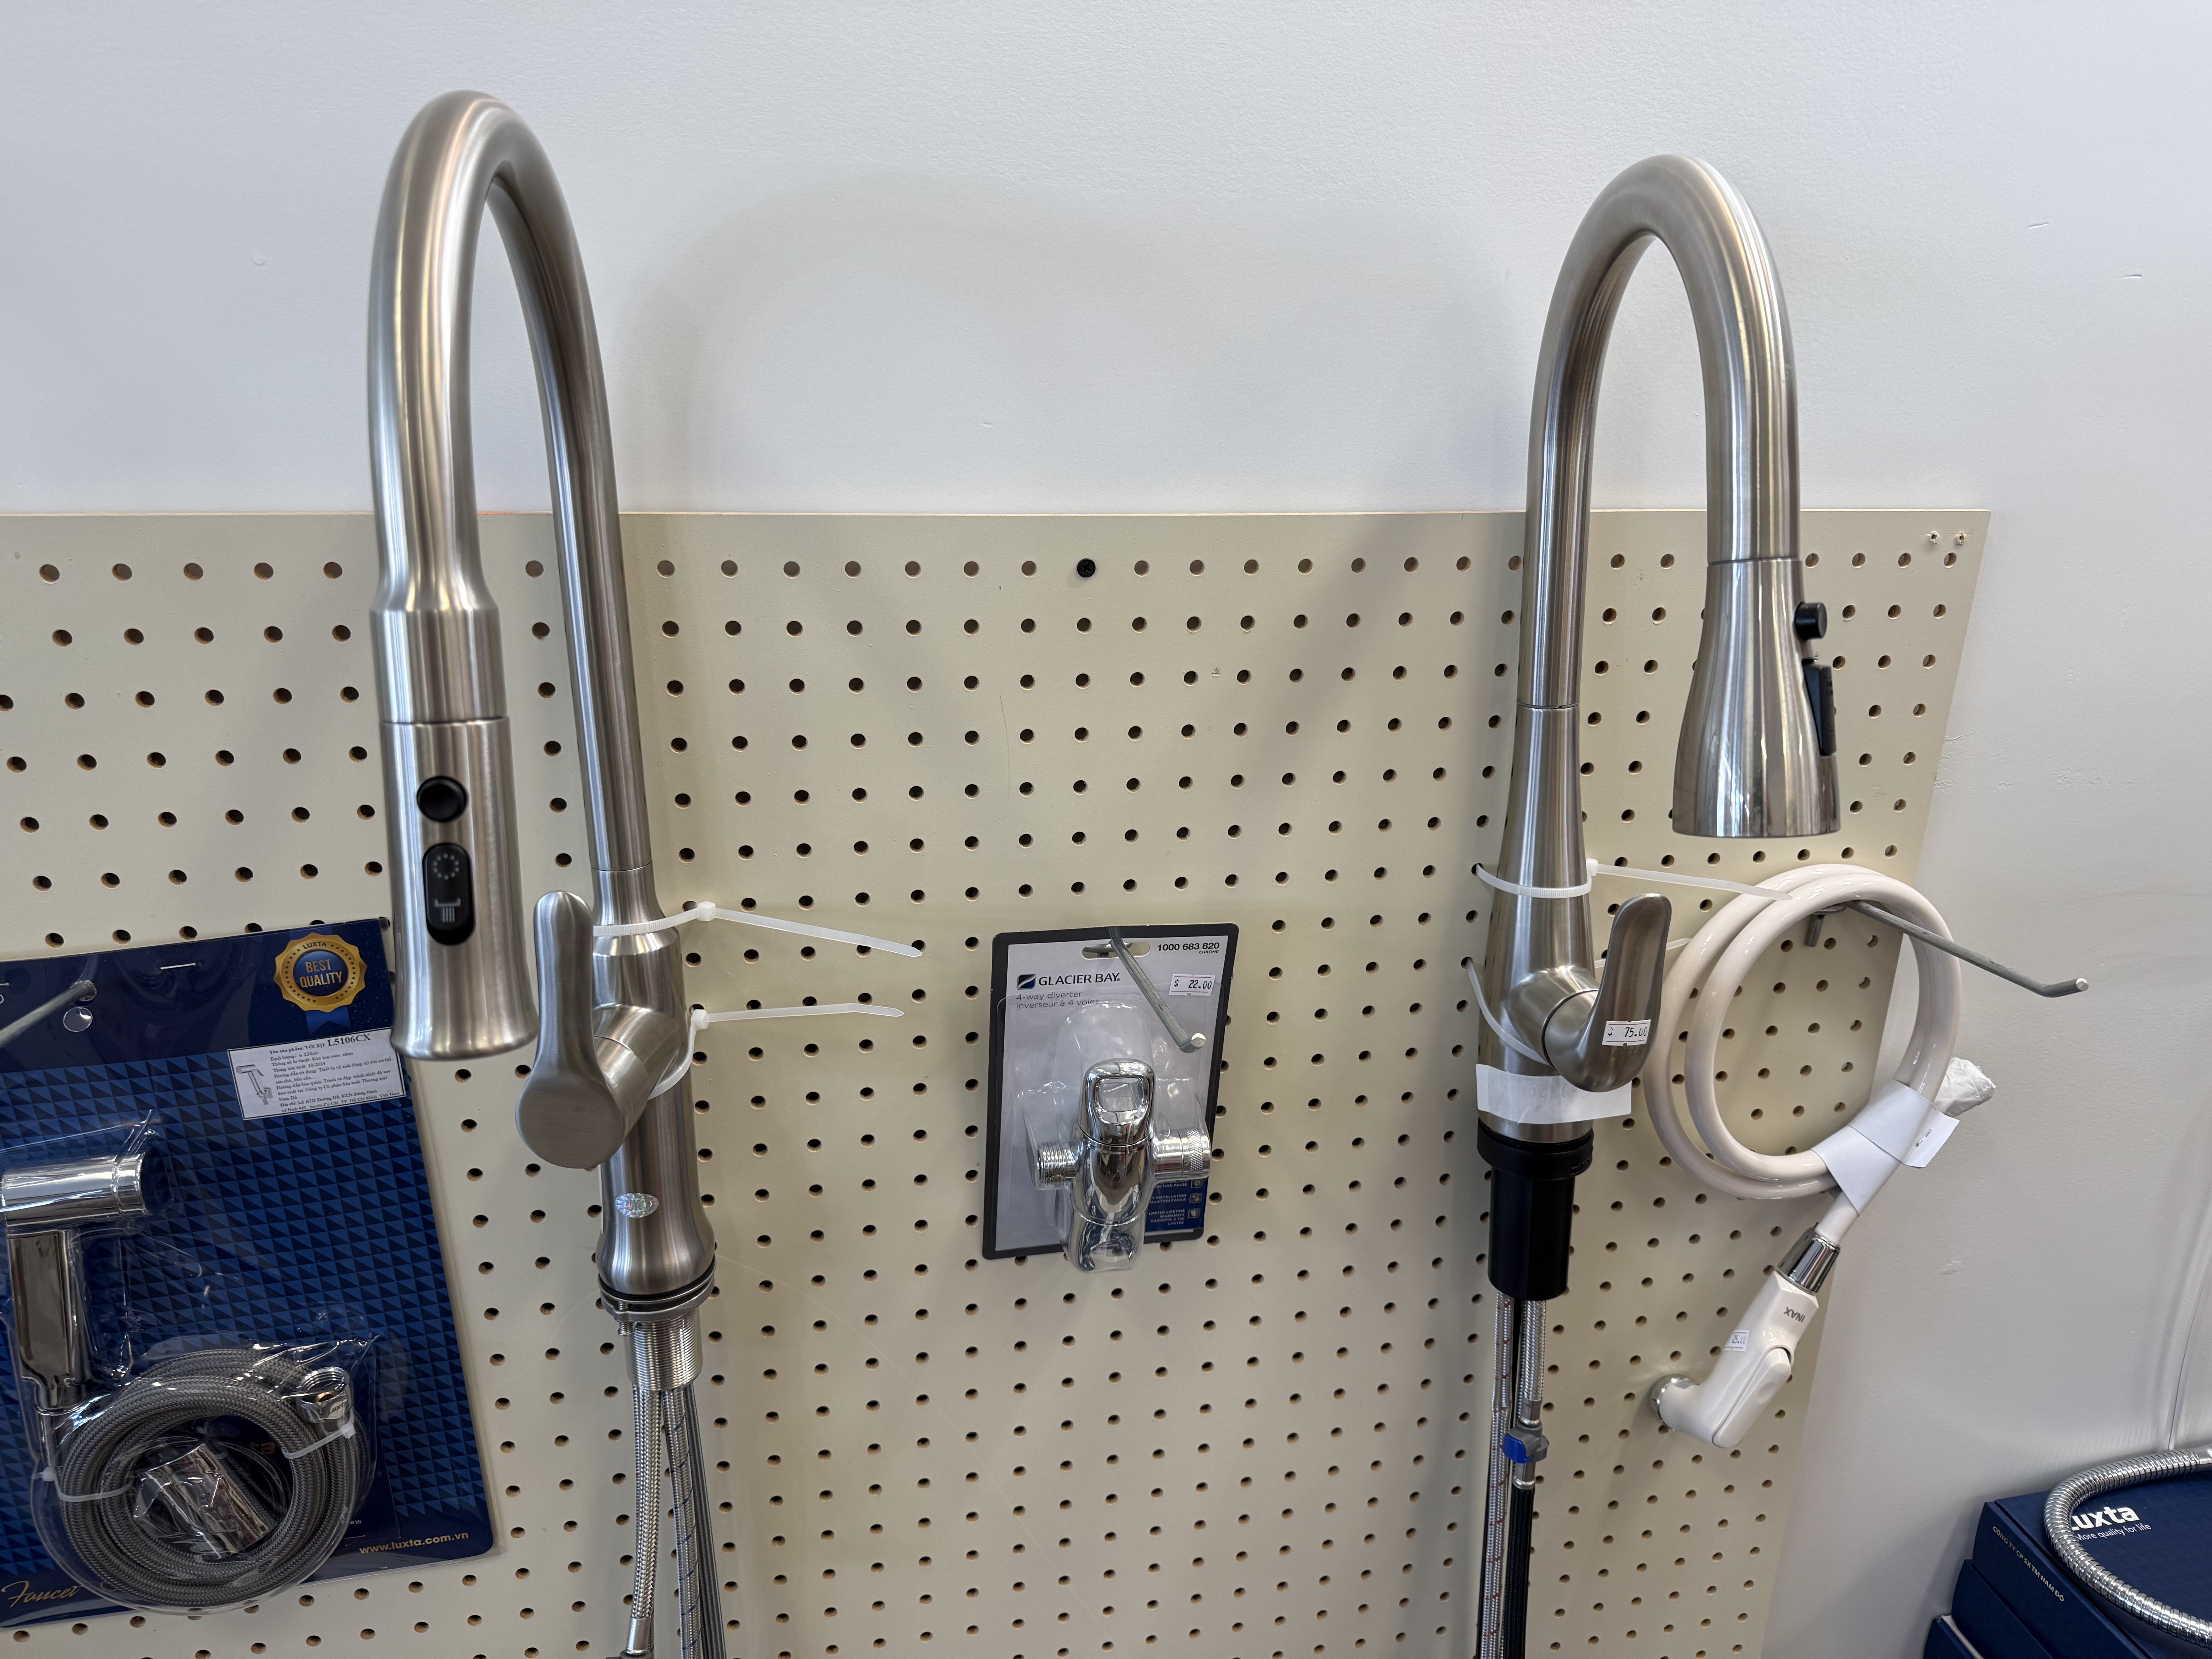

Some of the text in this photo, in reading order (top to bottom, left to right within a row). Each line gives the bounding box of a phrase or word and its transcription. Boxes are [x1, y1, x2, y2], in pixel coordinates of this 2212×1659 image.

[305, 959, 331, 973] BEST
[300, 971, 342, 988] QUALITY
[1038, 974, 1092, 986] GLACIER
[1188, 979, 1212, 989] 22.00
[1016, 1001, 1058, 1009] inverseur
[1625, 1027, 1647, 1037] 75.00
[327, 1034, 371, 1046] L5106CX
[1783, 1307, 1806, 1322] INAX
[2098, 1528, 2125, 1539] quality
[359, 1532, 469, 1554] www.luxta.com.vn
[2009, 1541, 2016, 1551] TY
[2016, 1550, 2024, 1558] CP
[2024, 1558, 2032, 1568] SX
[2032, 1565, 2040, 1577] TM
[2040, 1575, 2054, 1592] NAM
[1, 1580, 82, 1607] Faucet
